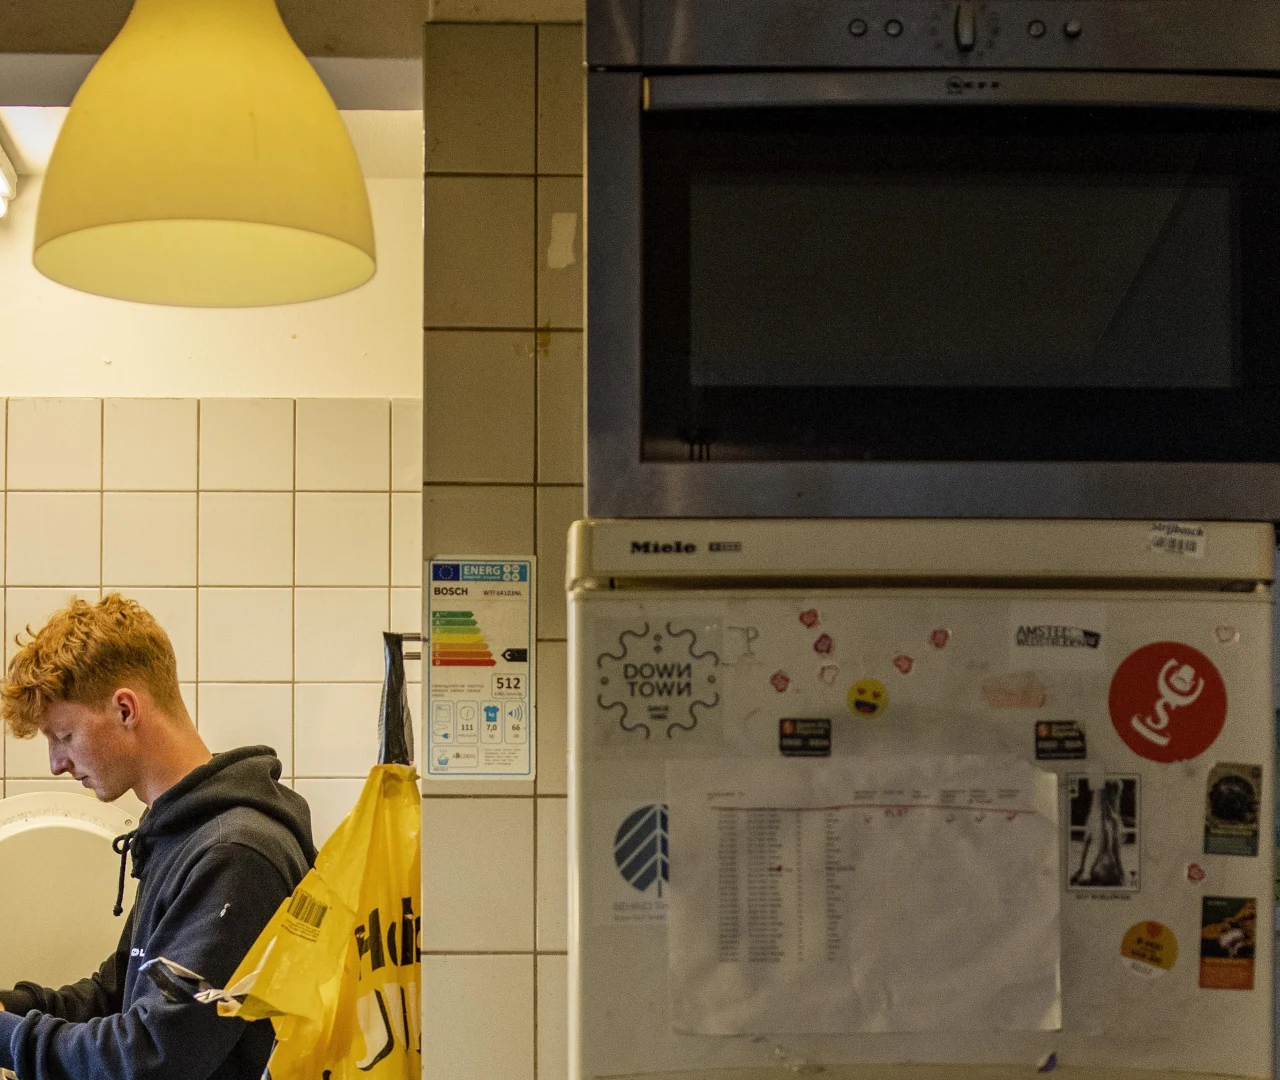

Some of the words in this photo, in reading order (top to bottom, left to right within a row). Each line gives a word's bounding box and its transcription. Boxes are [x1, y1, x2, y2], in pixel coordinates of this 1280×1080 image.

[631, 540, 697, 554] Miele
[463, 565, 500, 575] ENERG
[433, 587, 468, 596] BOSCH
[496, 677, 521, 689] 512
[486, 724, 498, 732] 7,0
